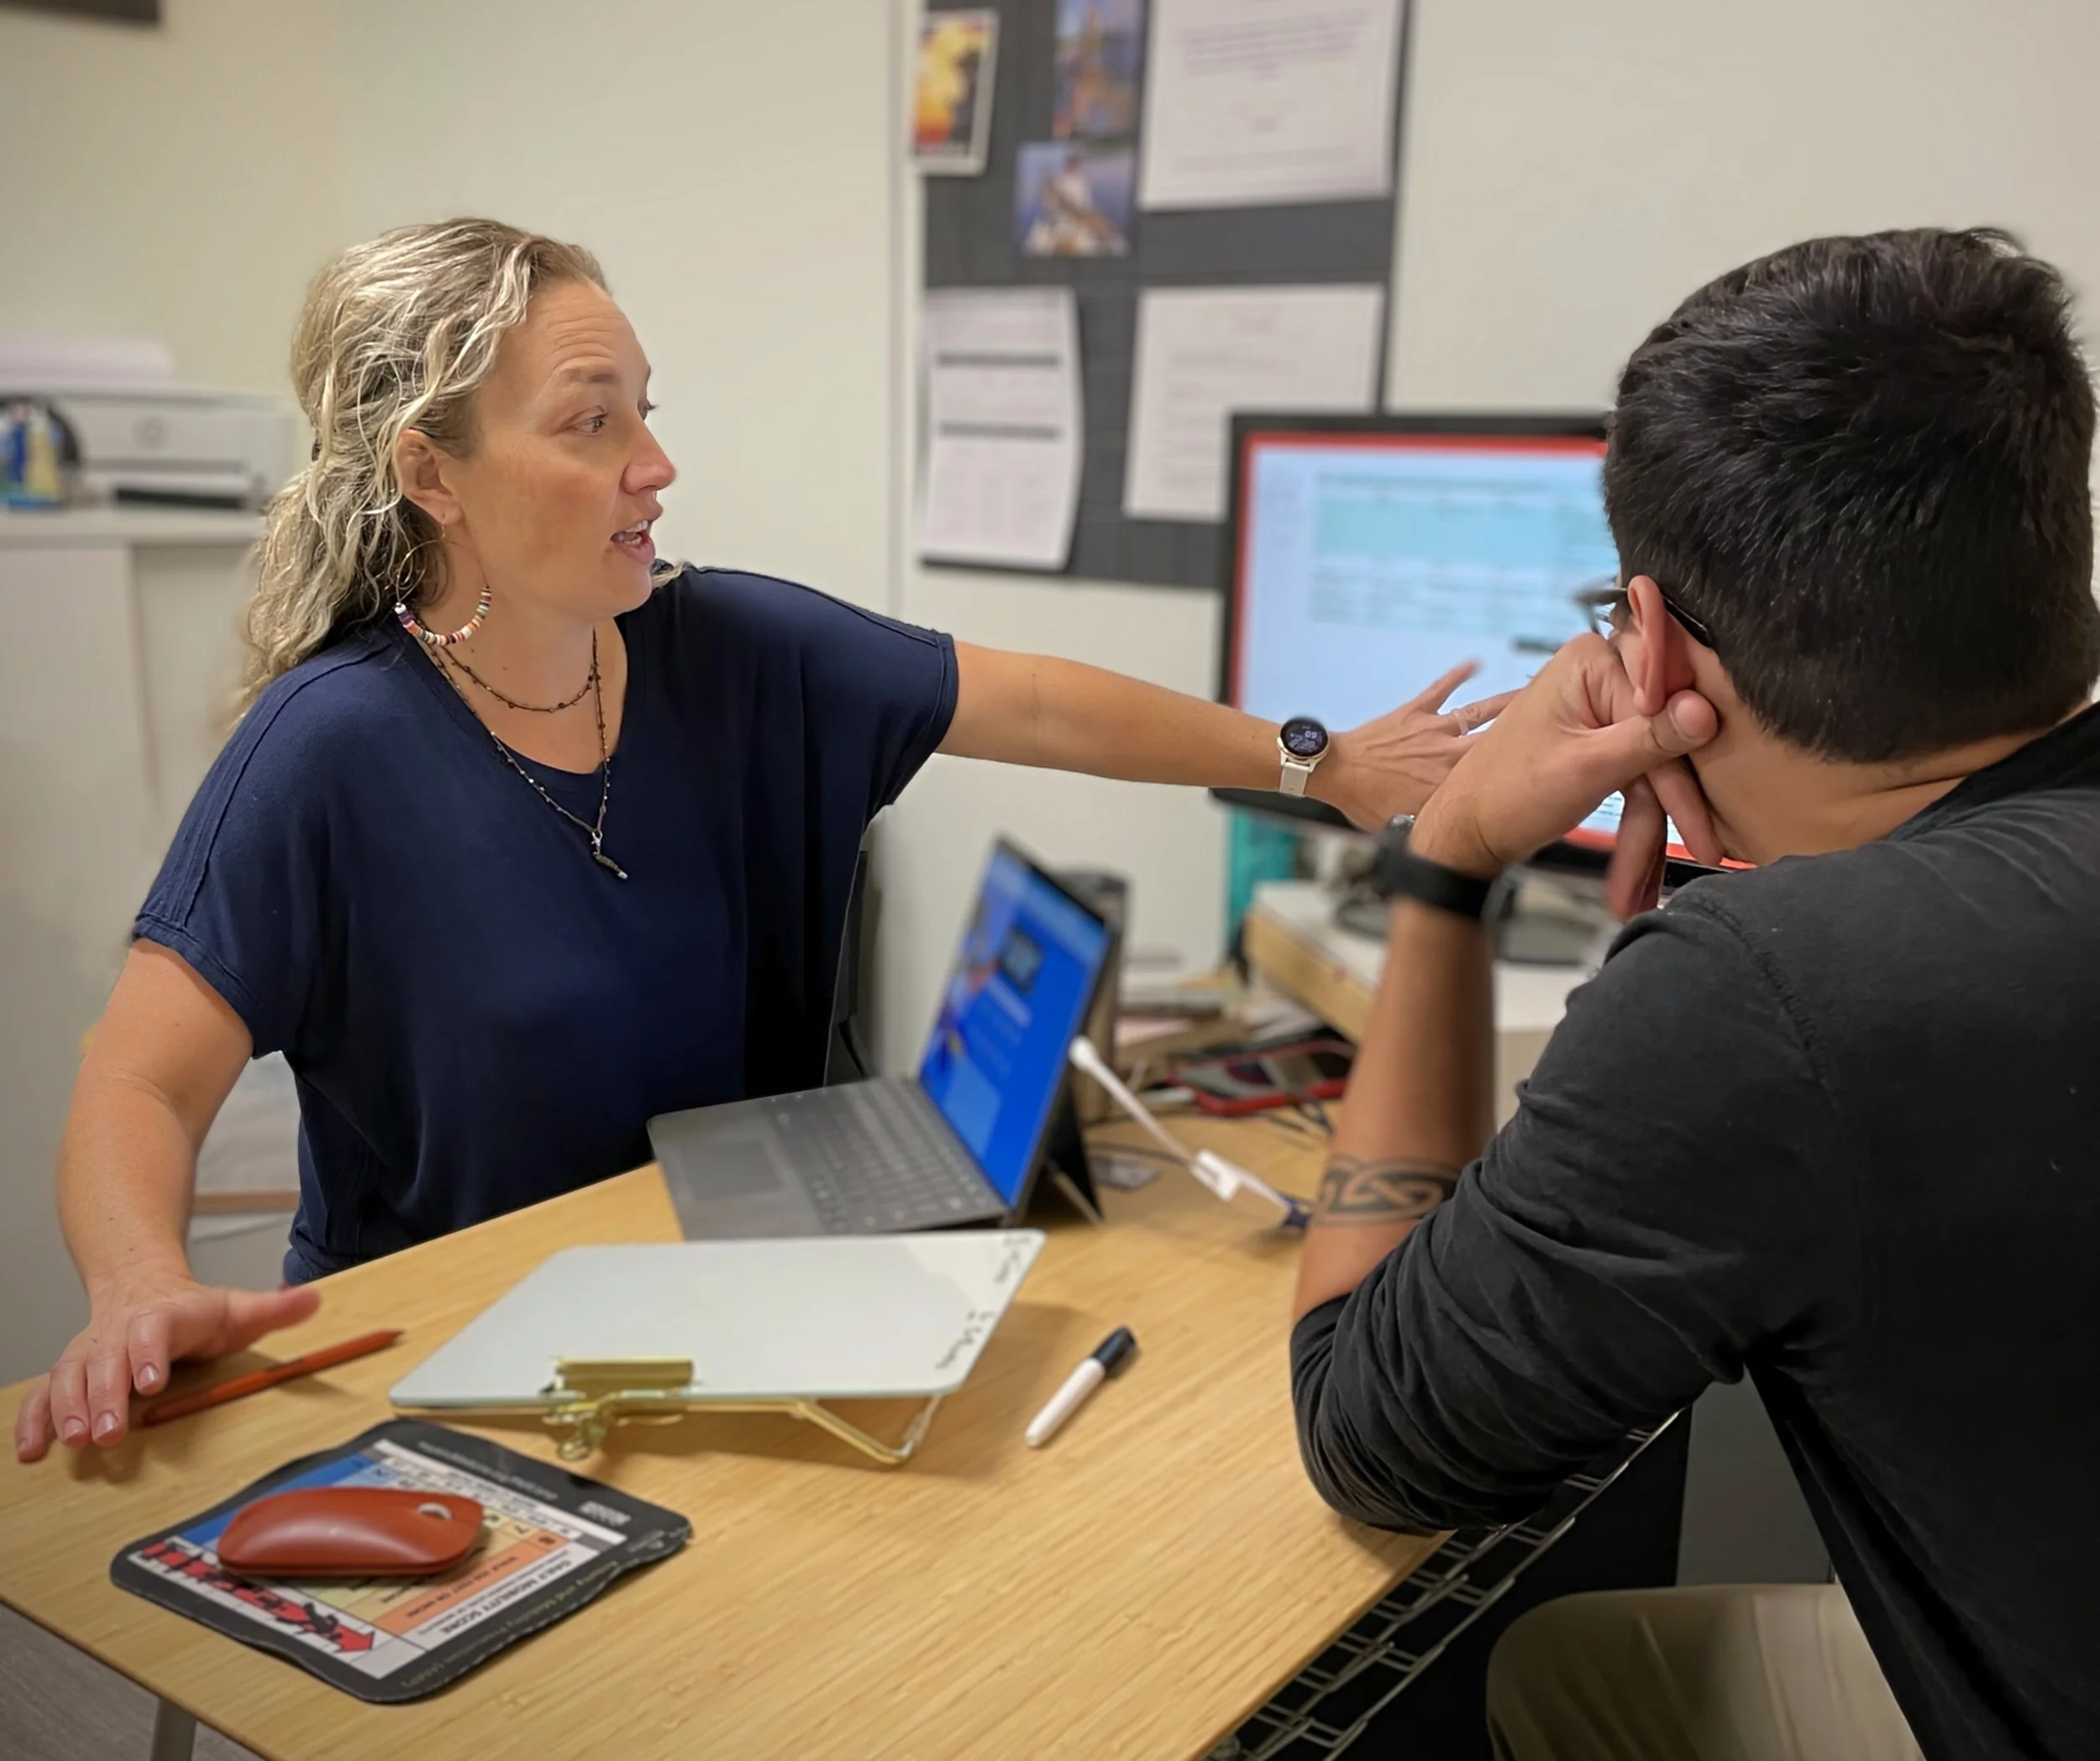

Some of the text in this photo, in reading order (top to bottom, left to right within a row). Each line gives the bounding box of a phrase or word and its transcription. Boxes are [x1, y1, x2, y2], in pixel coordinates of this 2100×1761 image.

[535, 1559, 574, 1580] DAILY
[480, 1578, 541, 1612] MOBILITY
[438, 1609, 484, 1635] SCORE
